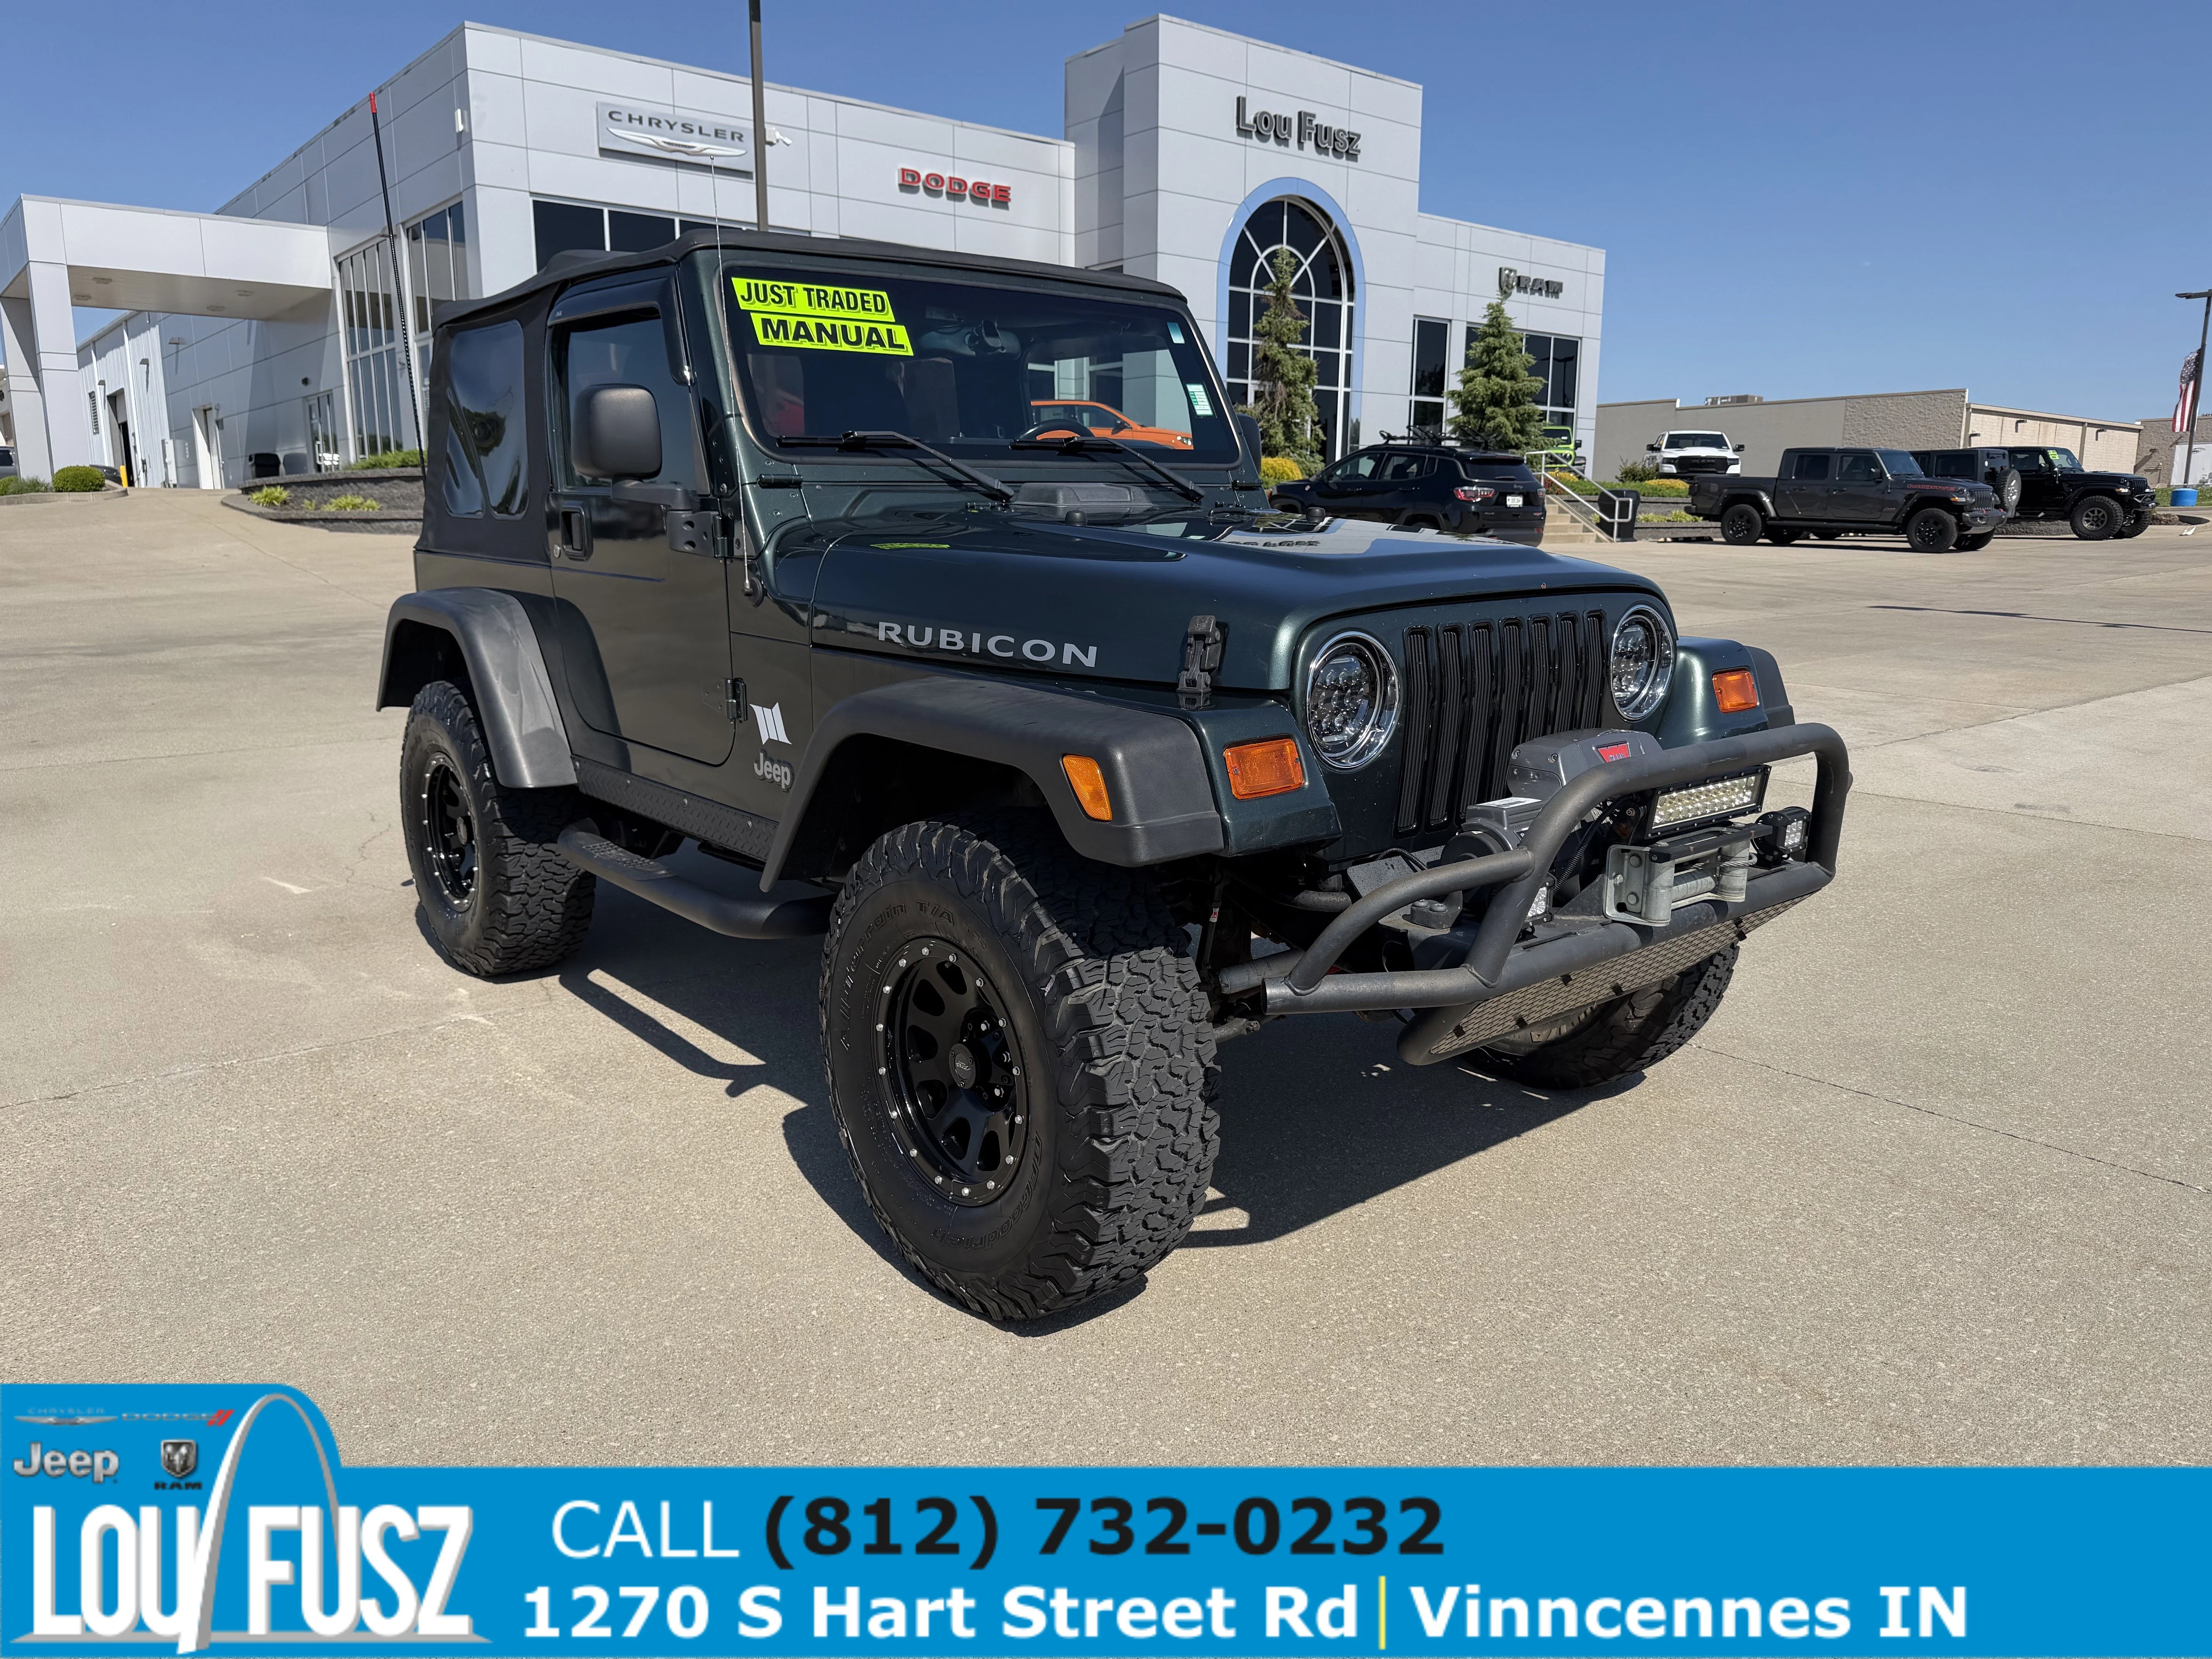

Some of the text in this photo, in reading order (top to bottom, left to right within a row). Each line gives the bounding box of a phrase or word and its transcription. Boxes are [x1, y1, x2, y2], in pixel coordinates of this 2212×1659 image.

[608, 110, 744, 143] CHRYSLER
[1237, 96, 1361, 155] Lou Fusz
[898, 167, 1012, 203] DODGE
[740, 282, 888, 314] JUST TRADED
[1516, 275, 1563, 293] RAM
[760, 317, 907, 350] MANUAL
[878, 622, 1097, 668] RUBICON
[754, 752, 792, 789] Jeep
